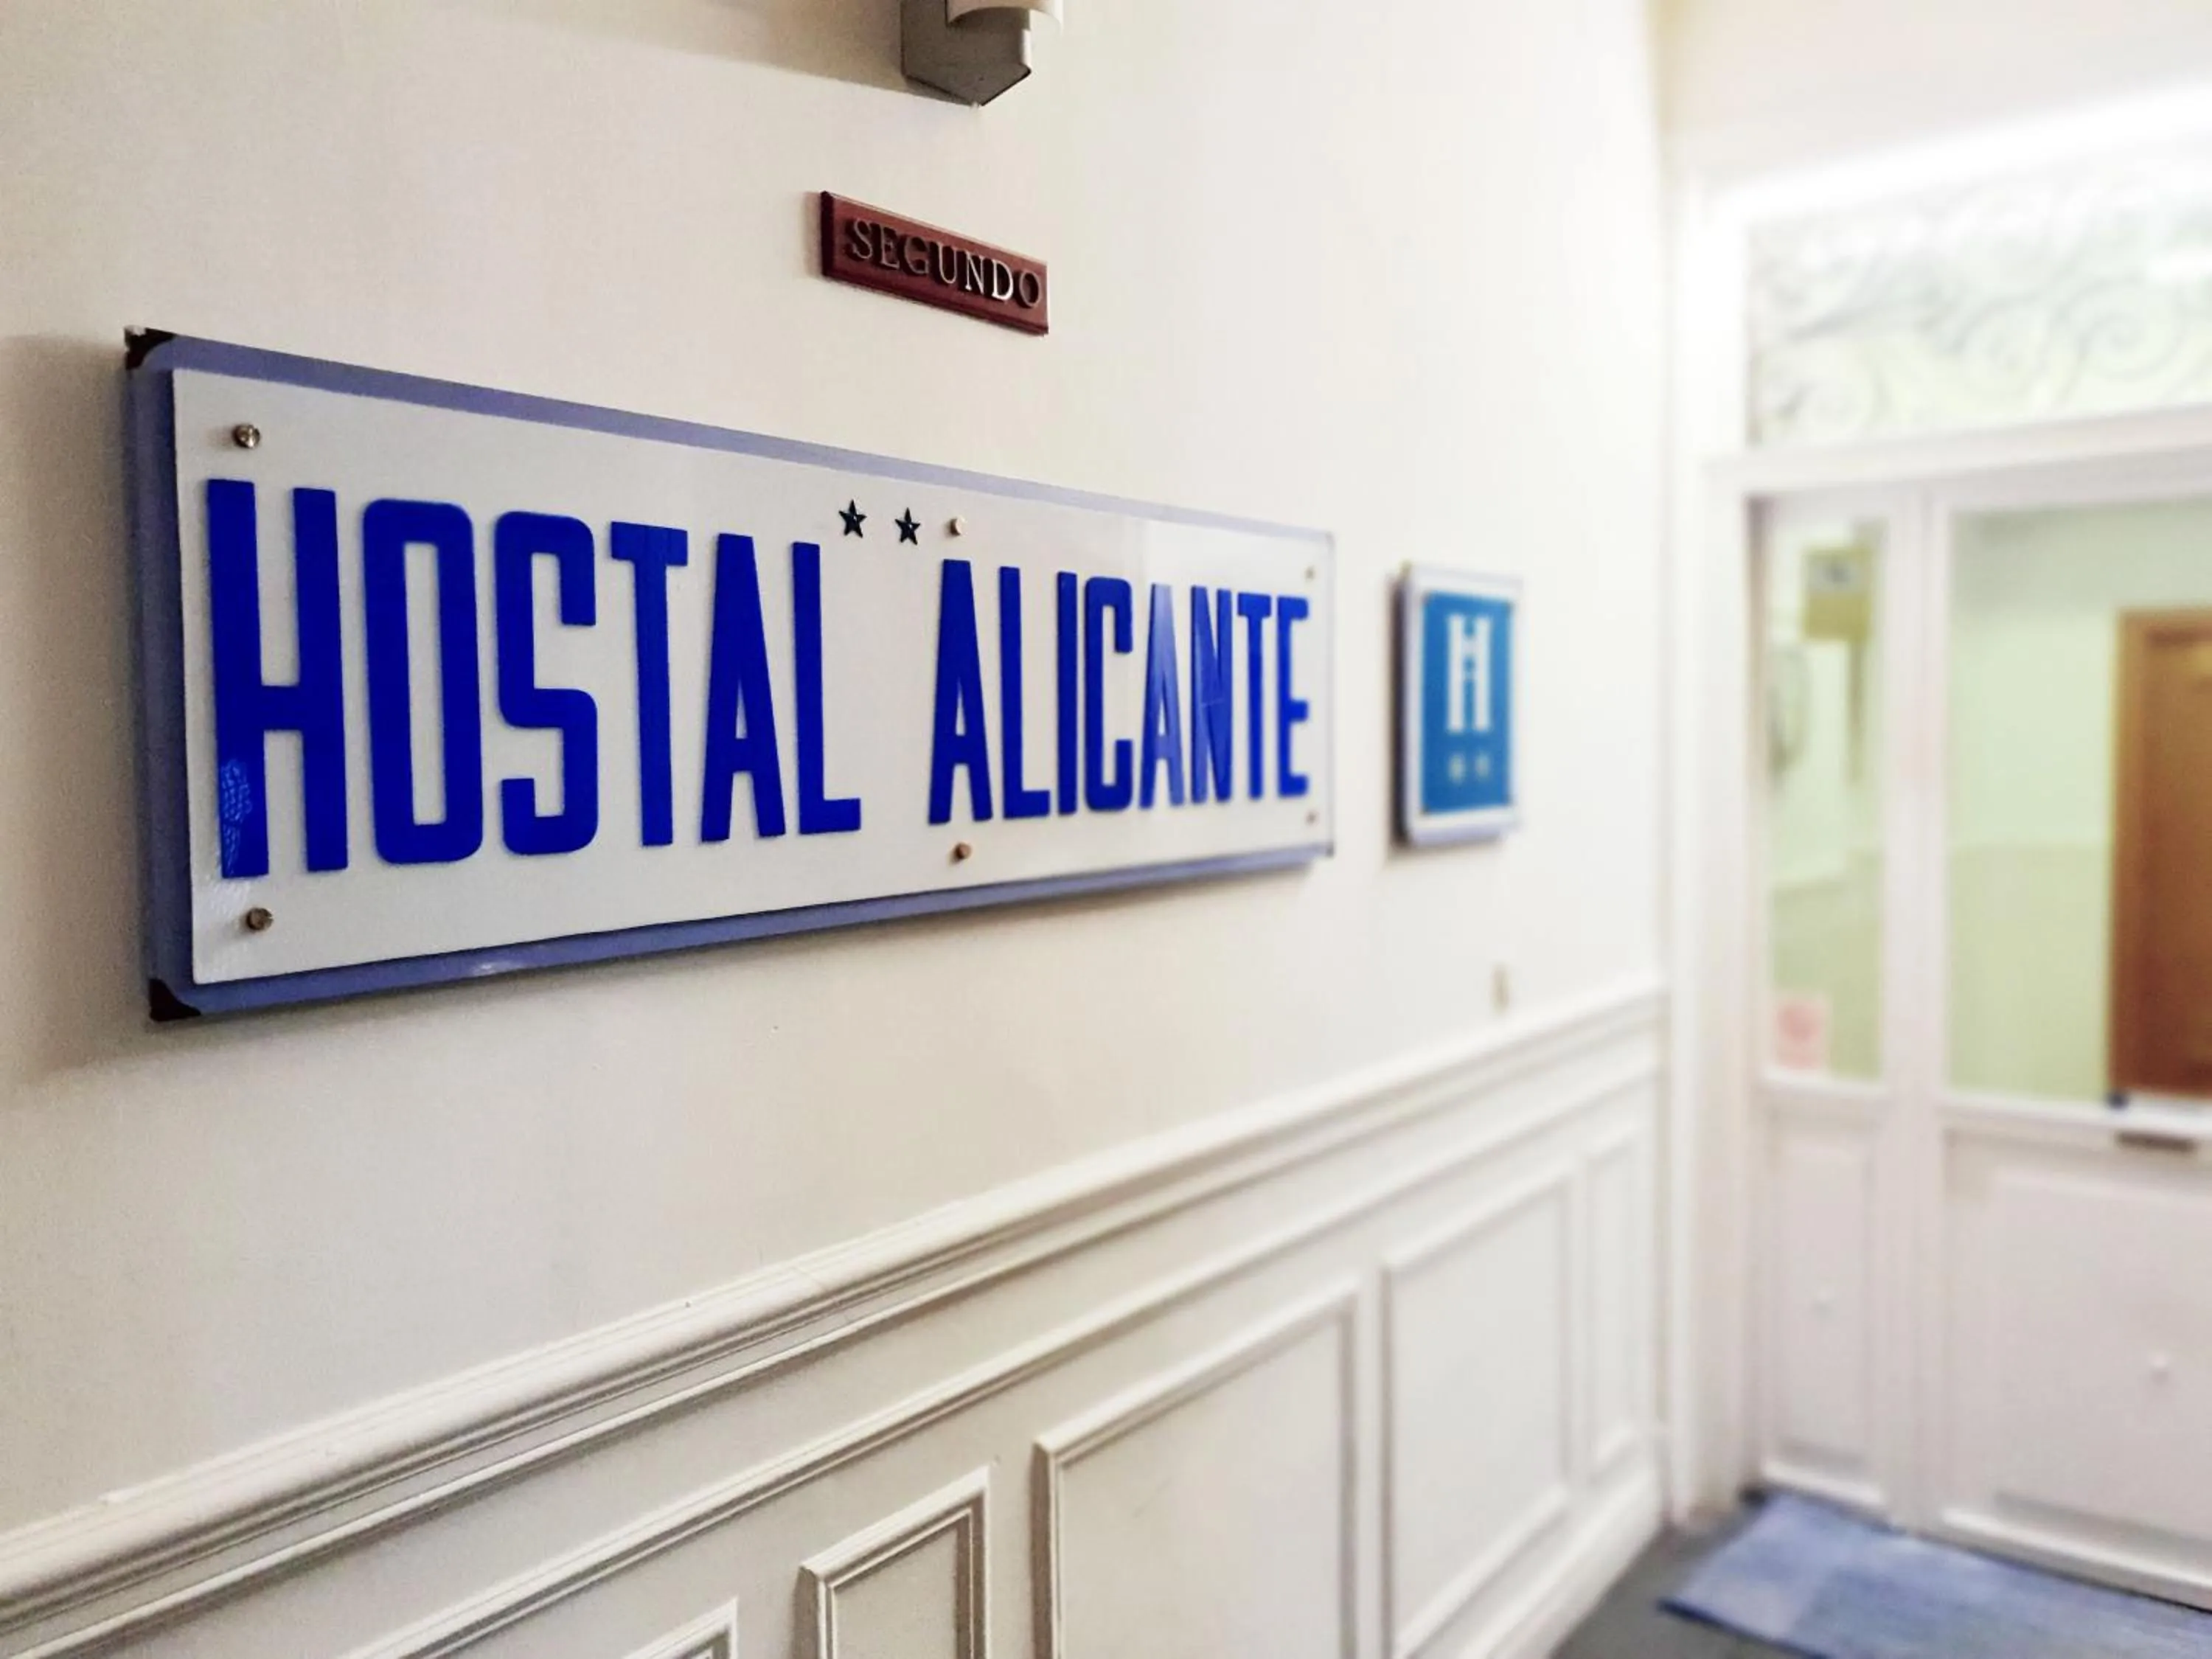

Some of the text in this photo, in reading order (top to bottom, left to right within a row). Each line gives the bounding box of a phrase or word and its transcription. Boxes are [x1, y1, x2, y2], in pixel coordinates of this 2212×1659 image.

[849, 218, 1040, 308] SEGUNDO
[207, 479, 1310, 877] HOSTAL ALICANTE
